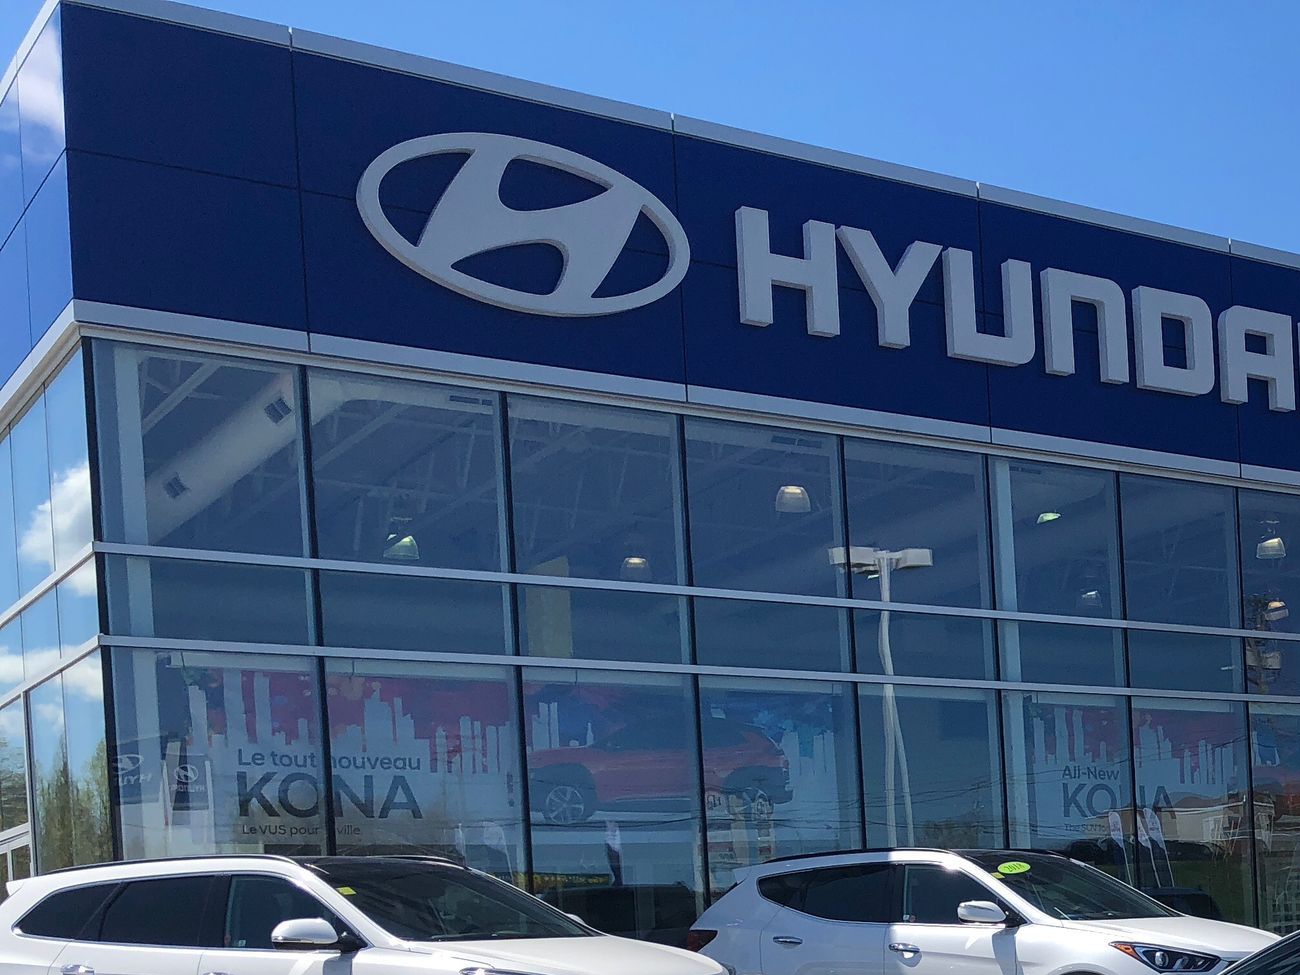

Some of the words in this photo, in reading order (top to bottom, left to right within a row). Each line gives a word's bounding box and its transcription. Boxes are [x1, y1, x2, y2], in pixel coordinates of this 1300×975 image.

[237, 748, 266, 767] Le
[271, 751, 317, 769] tout
[1062, 765, 1120, 780] All-New
[236, 771, 424, 819] KONA
[242, 825, 257, 835] Le
[259, 825, 287, 835] VUS
[290, 826, 320, 837] pour
